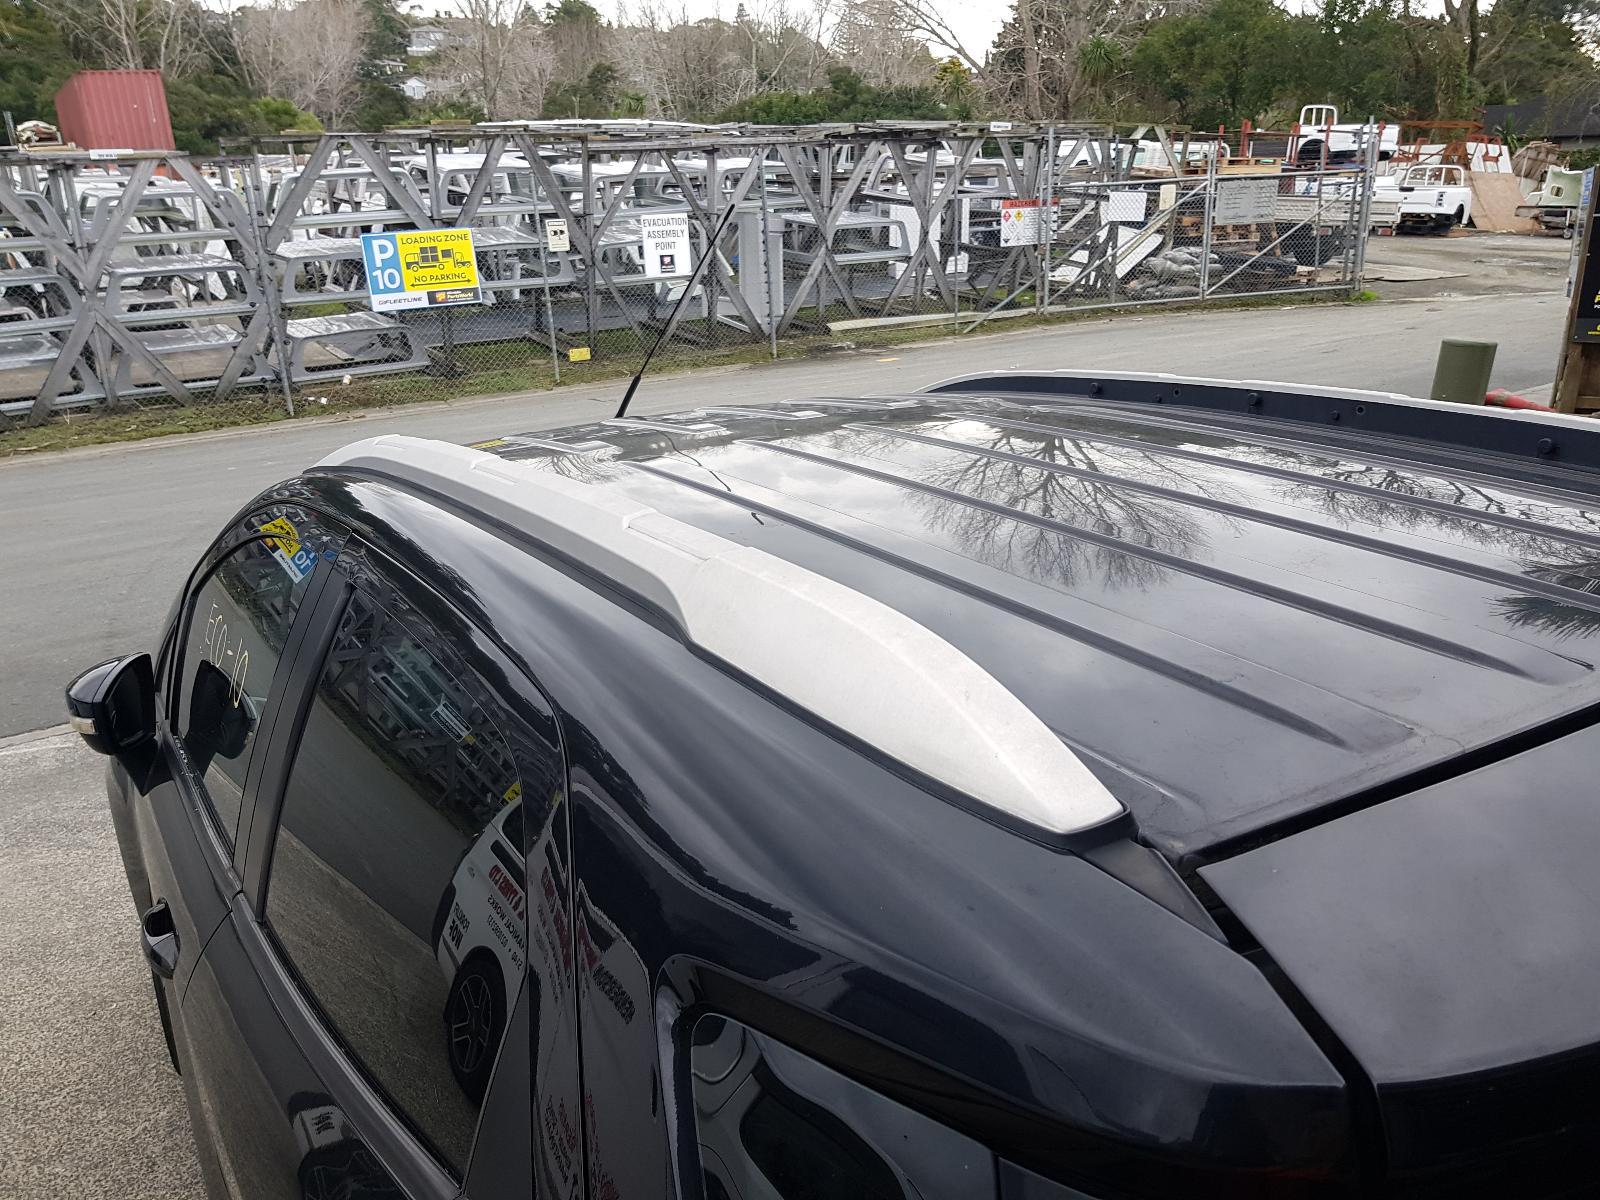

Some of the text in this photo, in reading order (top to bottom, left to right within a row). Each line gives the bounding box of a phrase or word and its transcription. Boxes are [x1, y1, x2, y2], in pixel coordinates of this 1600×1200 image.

[642, 217, 688, 228] EVACUATION
[401, 233, 470, 245] LOADING ZONE
[647, 229, 685, 239] ASSEMBLY
[655, 241, 677, 251] POINT
[371, 238, 395, 268] P
[372, 268, 401, 290] 10
[414, 272, 467, 283] NO PARKING
